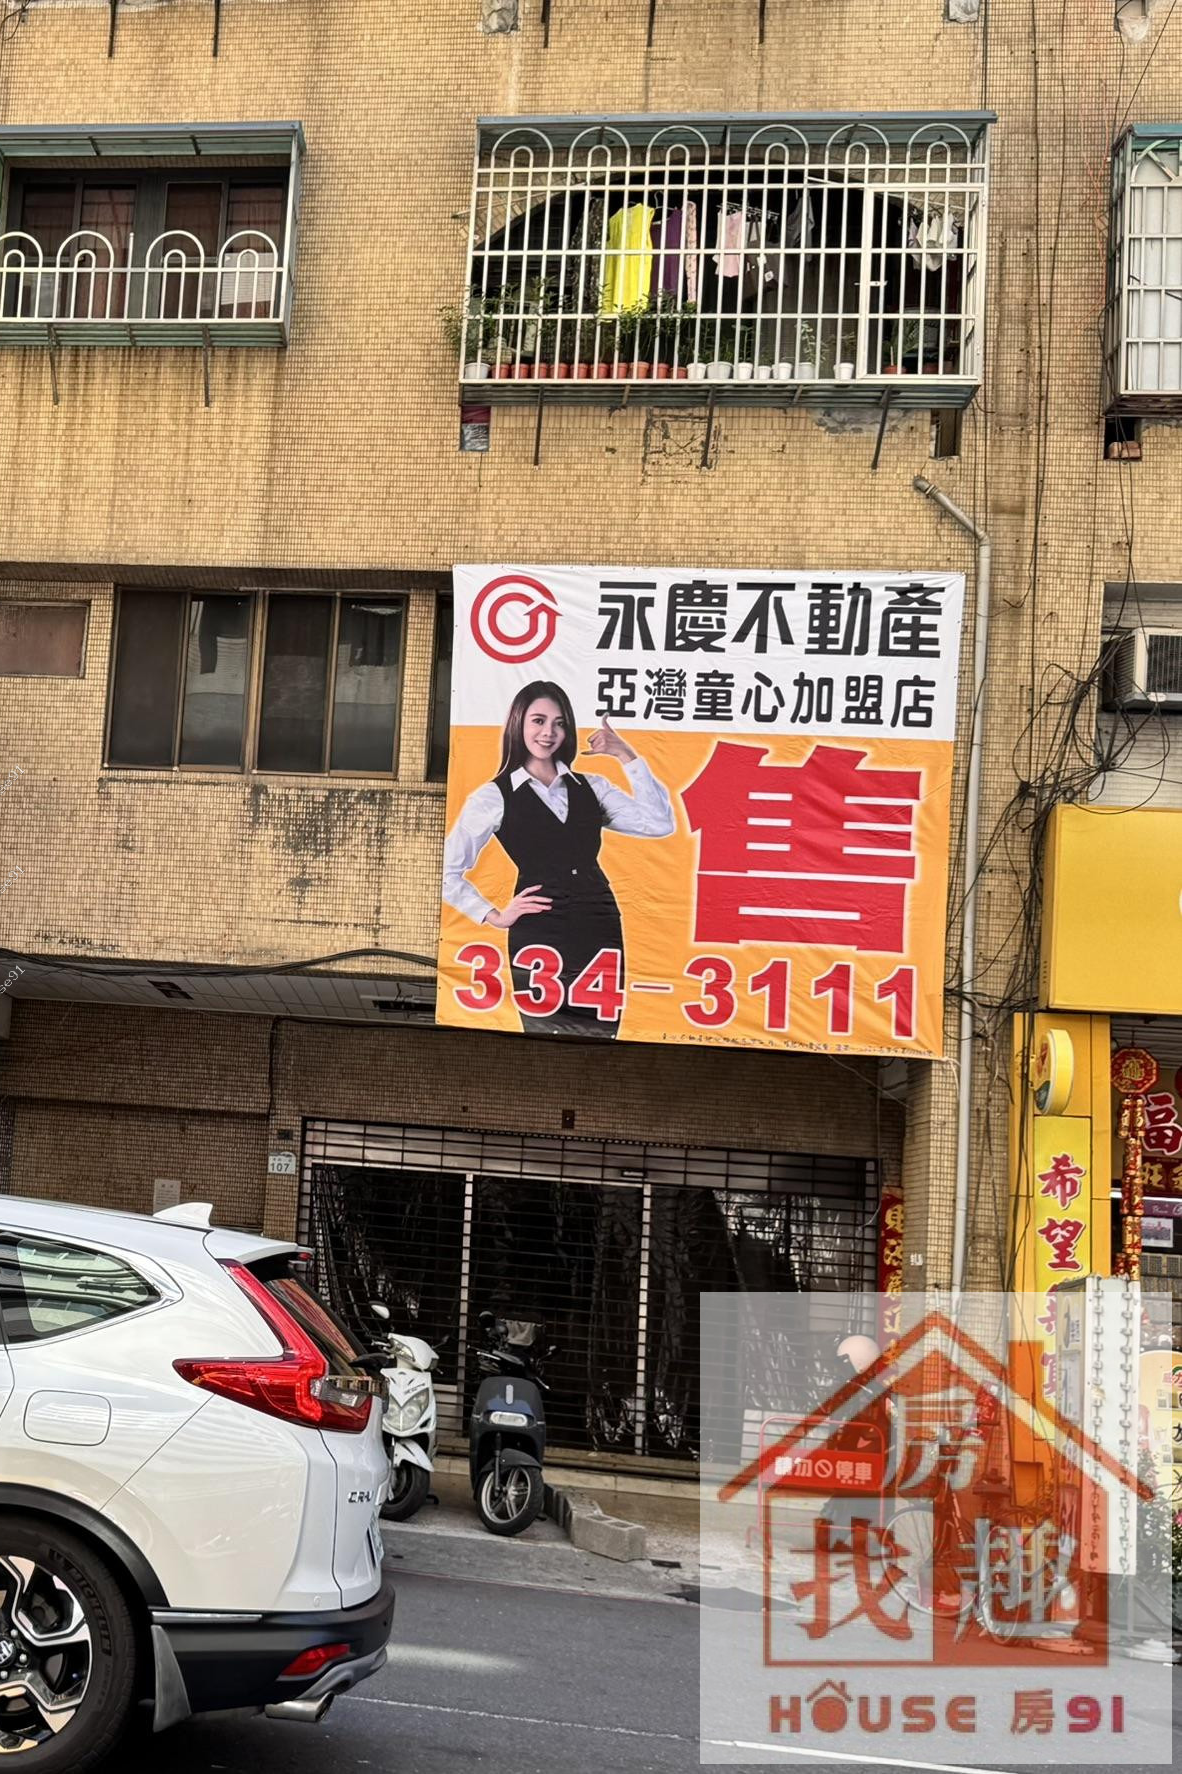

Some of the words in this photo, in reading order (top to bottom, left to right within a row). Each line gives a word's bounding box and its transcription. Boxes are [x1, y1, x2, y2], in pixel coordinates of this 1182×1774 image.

[594, 579, 946, 660] 永慶不動產
[594, 666, 937, 728] 亞灣童心加盟店
[680, 740, 923, 954] 售
[453, 943, 918, 1040] 334-3111
[269, 1161, 291, 1173] 107
